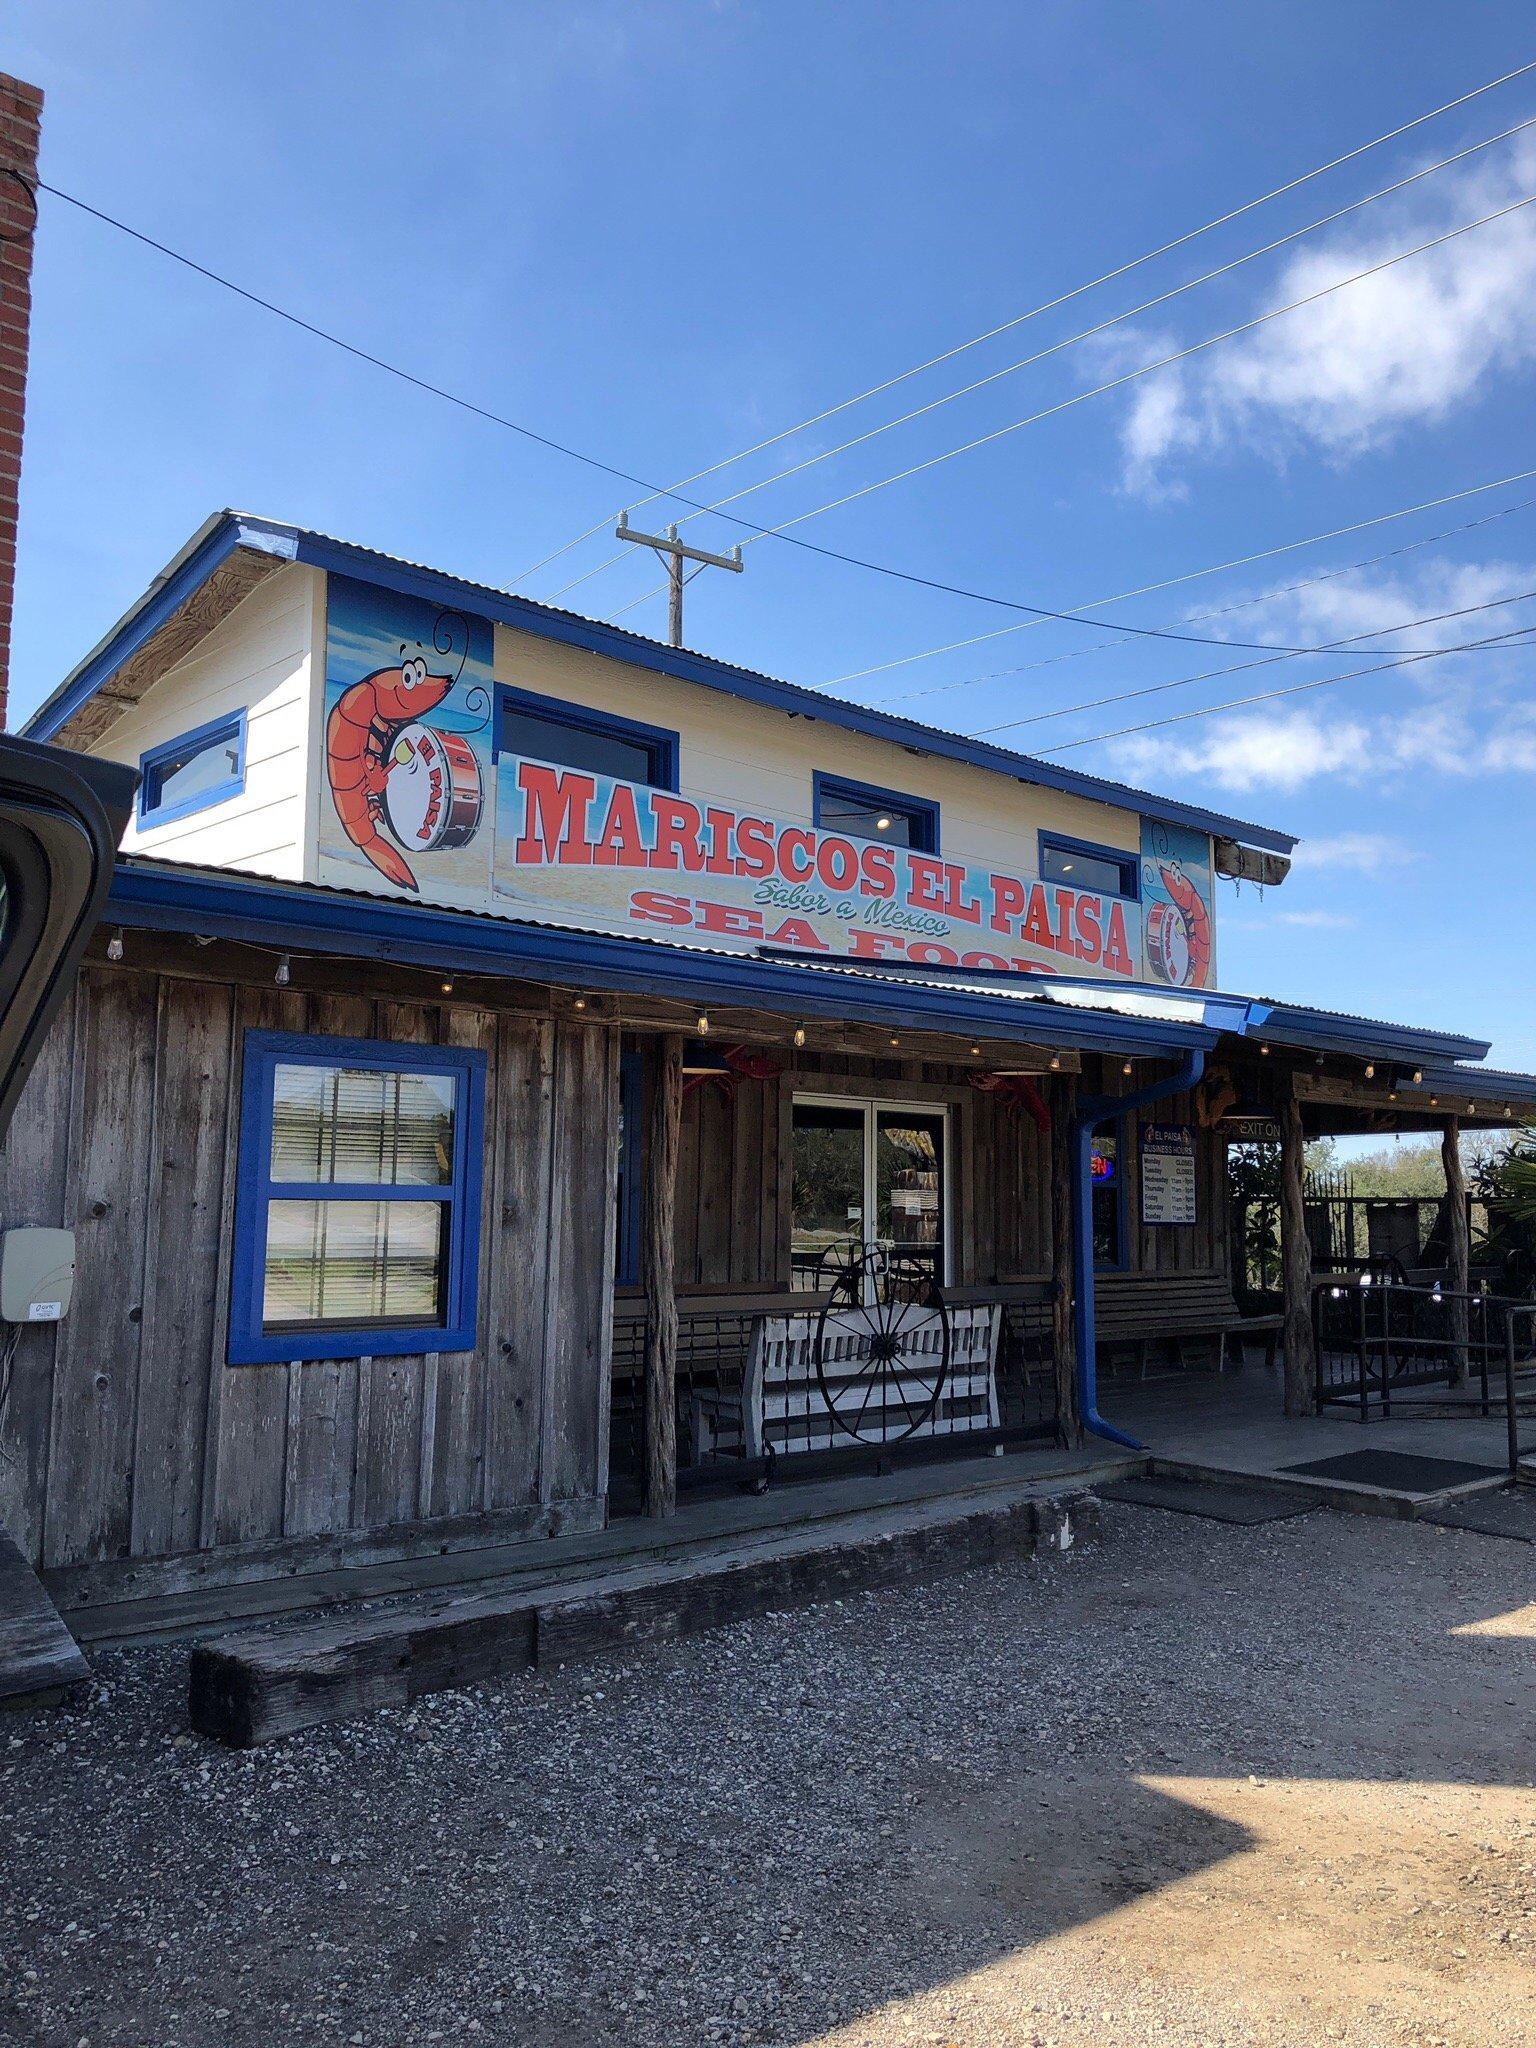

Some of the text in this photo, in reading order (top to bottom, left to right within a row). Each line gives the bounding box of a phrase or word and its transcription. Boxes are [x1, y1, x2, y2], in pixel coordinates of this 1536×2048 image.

[416, 734, 442, 840] EL PAISA
[516, 762, 1133, 977] MARISCOS EL PAISA
[756, 878, 949, 936] Sabor a Mexico
[630, 890, 830, 951] SEA
[1239, 1121, 1281, 1138] EXIT ON
[1154, 1131, 1182, 1142] EL PAISA
[1144, 1144, 1193, 1155] BUSINESS HOURS
[1144, 1157, 1193, 1167] Monday CLOSED
[1144, 1166, 1194, 1176] Tuesday CLOSED
[1144, 1176, 1169, 1184] Wednesday
[1144, 1184, 1165, 1193] Thursday
[1145, 1193, 1158, 1203] Friday
[1145, 1203, 1164, 1212] Saturday
[1145, 1212, 1162, 1221] Sunday
